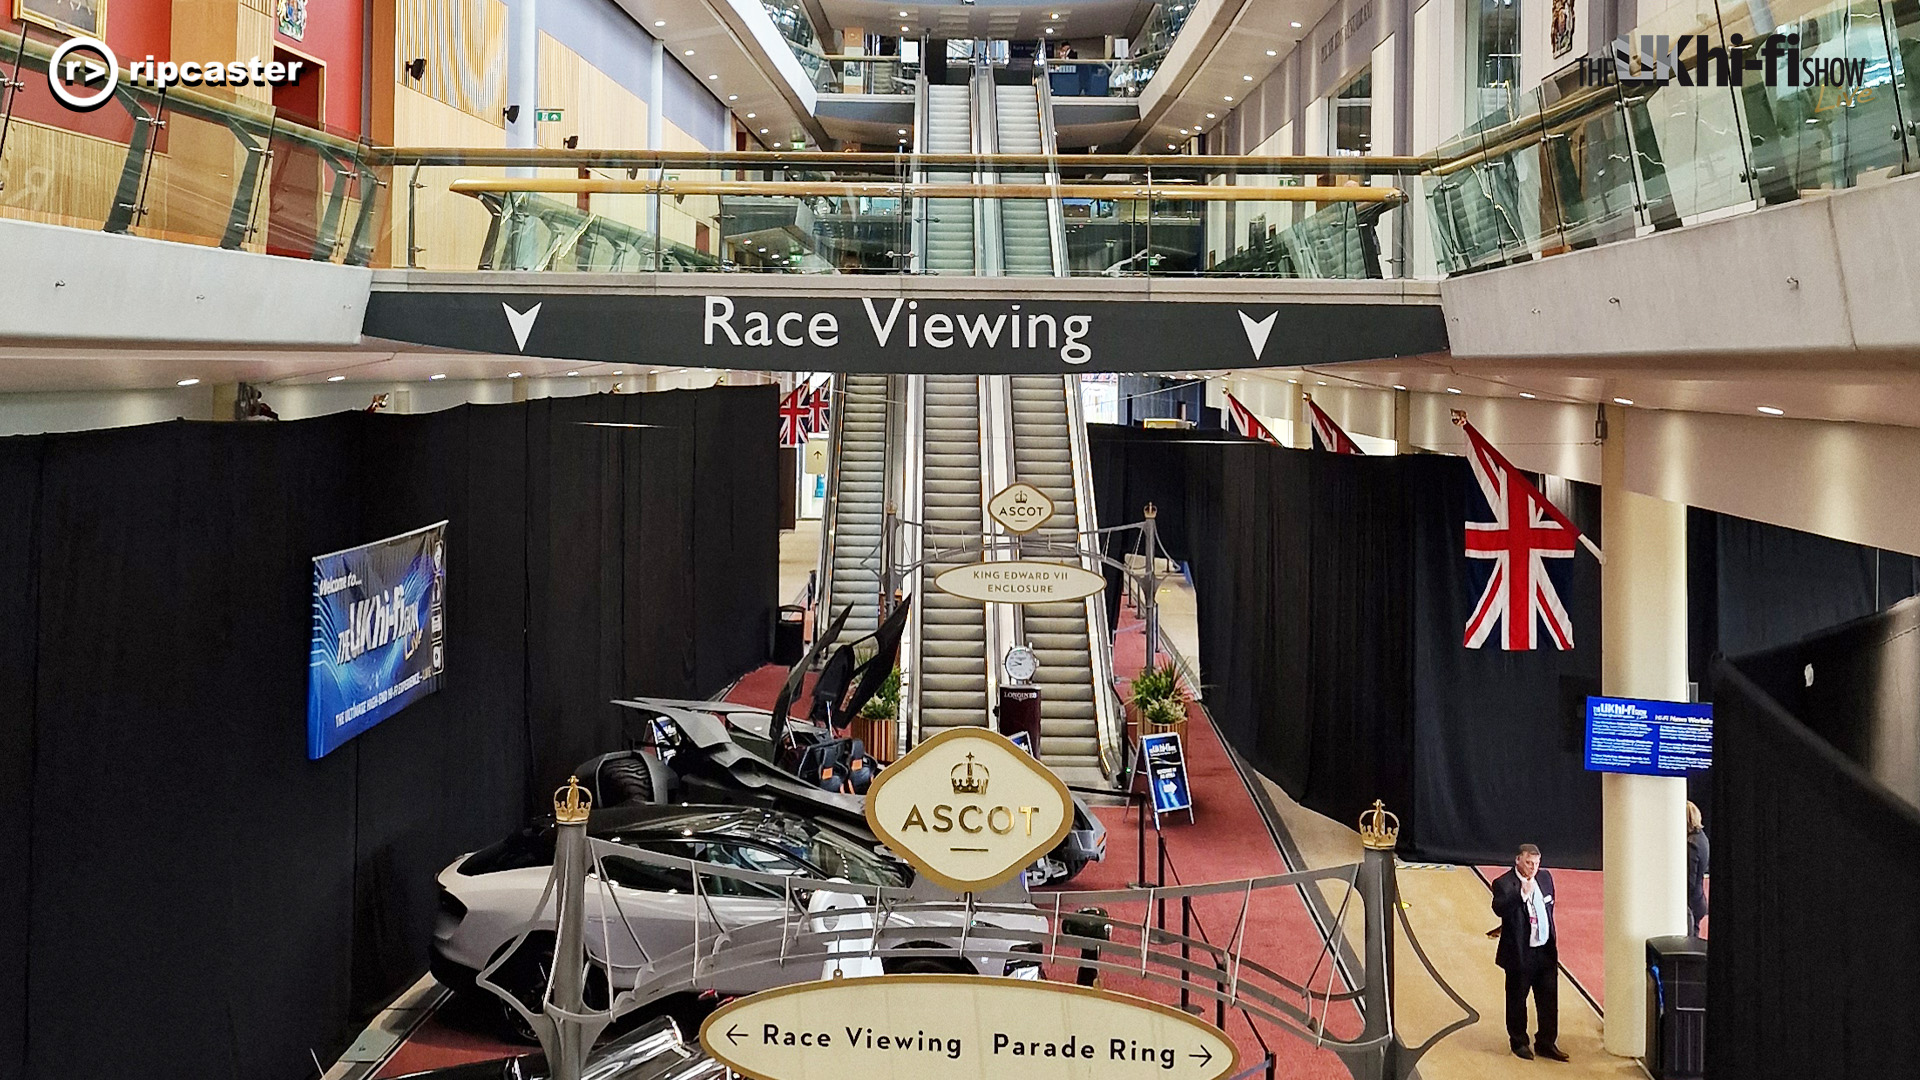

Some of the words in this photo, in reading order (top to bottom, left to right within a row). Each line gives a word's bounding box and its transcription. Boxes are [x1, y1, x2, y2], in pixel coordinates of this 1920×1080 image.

[703, 296, 840, 348] Race
[862, 297, 1093, 365] Viewing
[999, 506, 1044, 517] ASCOT
[973, 571, 1000, 580] KING
[1004, 571, 1050, 580] EDWARD
[1053, 571, 1068, 581] VII
[320, 576, 347, 597] Welcome
[988, 584, 1053, 594] ENCLOSURE
[1003, 691, 1037, 699] LONGINES
[901, 804, 1040, 837] ASCOT
[763, 1023, 832, 1049] Race
[845, 1026, 962, 1059] Viewing
[993, 1033, 1095, 1060] Parade
[1109, 1038, 1176, 1070] Ring
